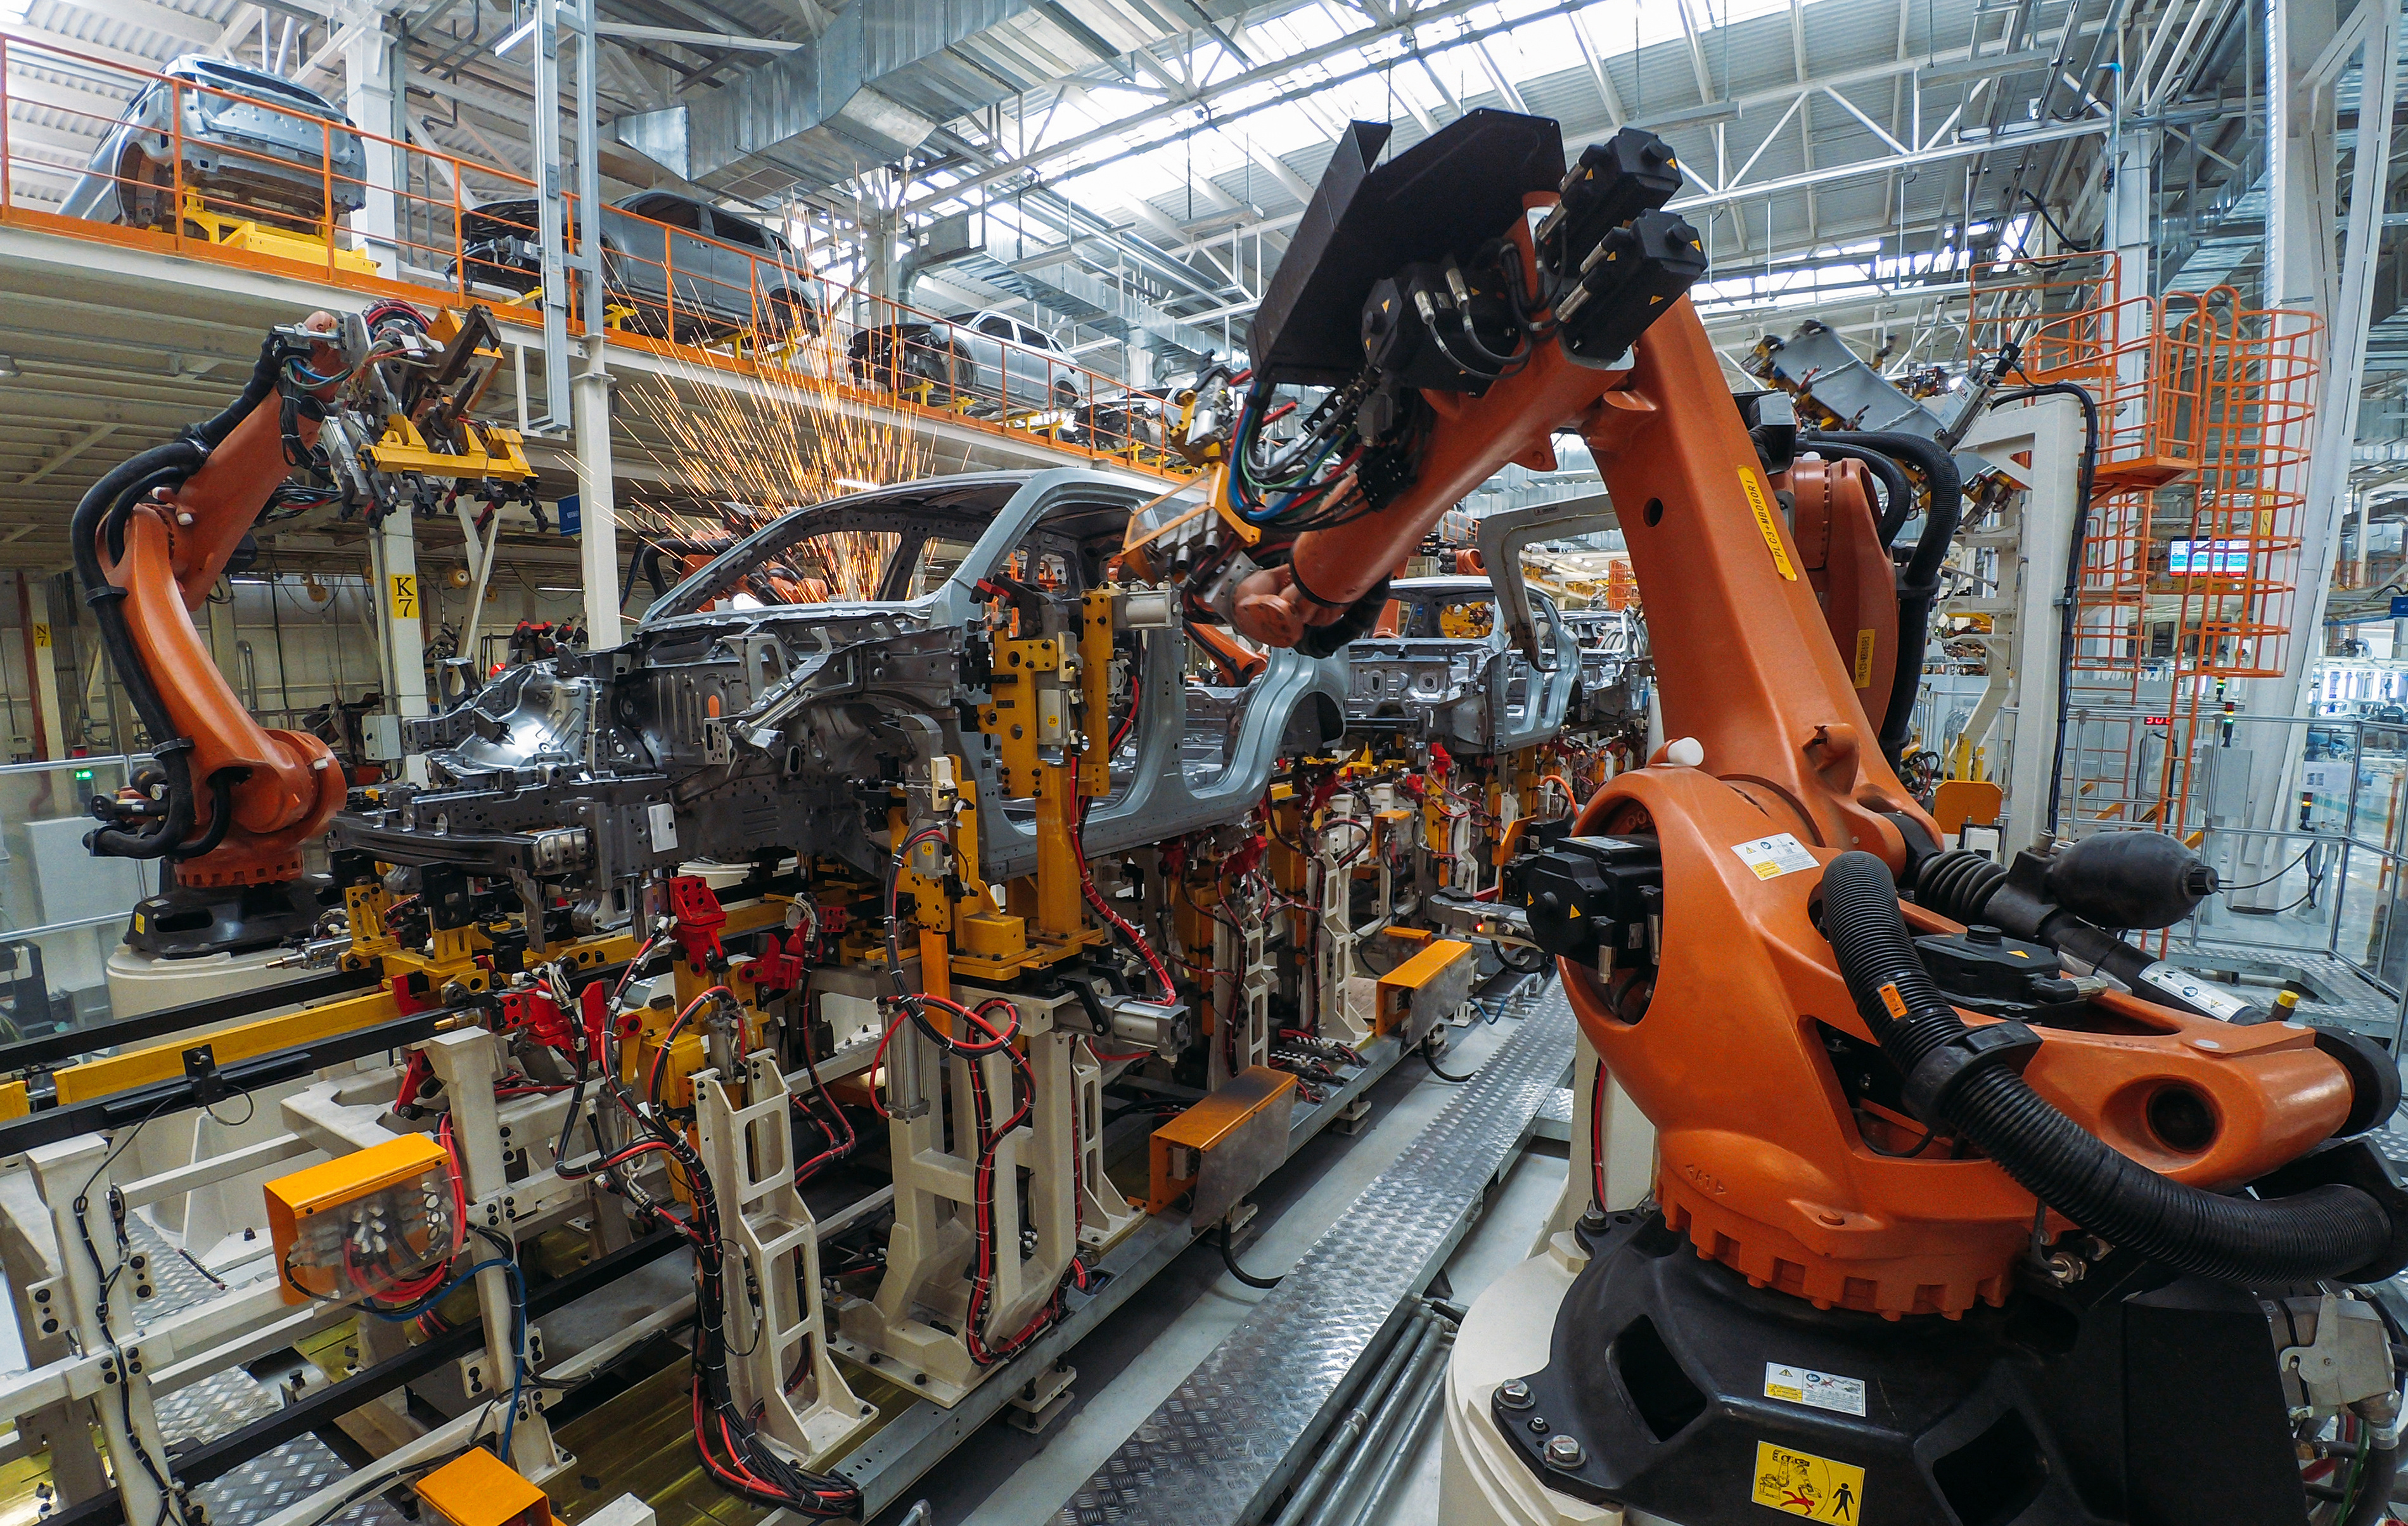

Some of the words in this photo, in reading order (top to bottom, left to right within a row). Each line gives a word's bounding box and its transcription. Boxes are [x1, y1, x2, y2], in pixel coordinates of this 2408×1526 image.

[394, 577, 414, 596] K
[398, 598, 413, 617] 7
[36, 625, 47, 636] N
[37, 636, 46, 646] 7
